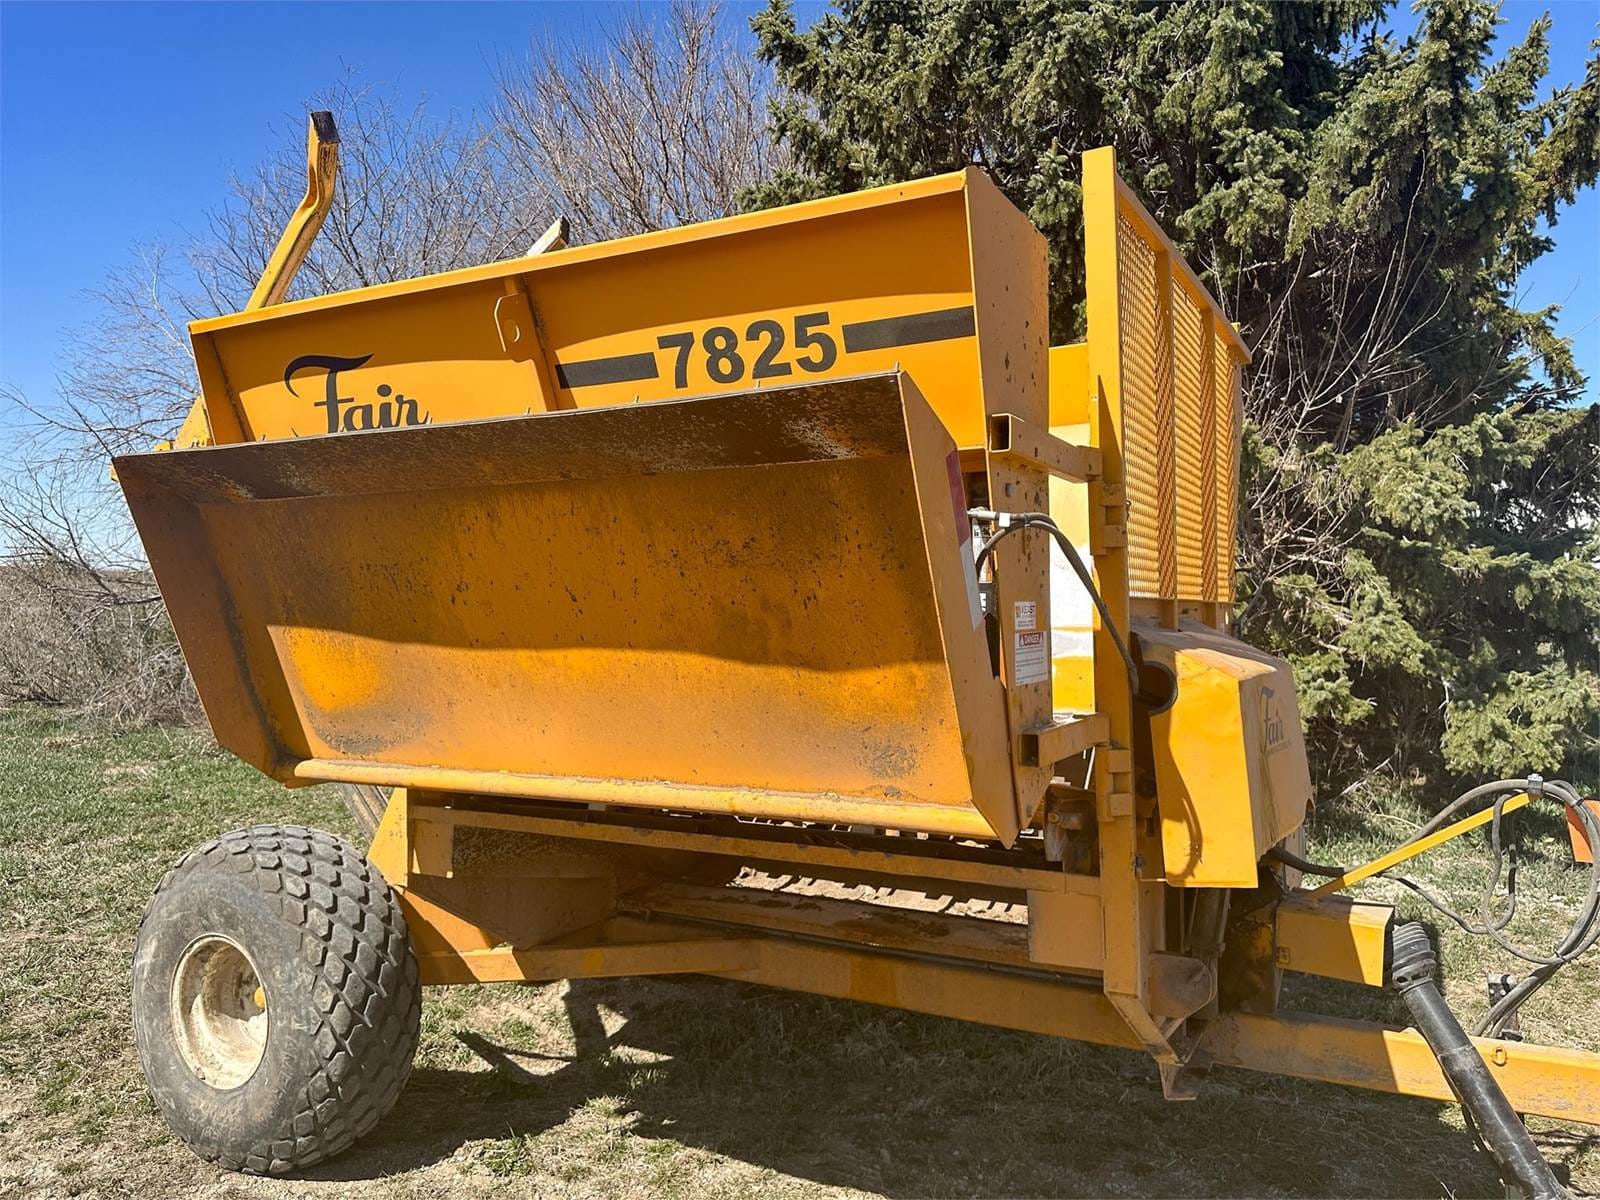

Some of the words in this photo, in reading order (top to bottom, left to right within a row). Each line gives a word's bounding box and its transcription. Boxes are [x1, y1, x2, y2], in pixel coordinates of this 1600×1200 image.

[656, 311, 838, 389] 7825
[284, 353, 430, 433] Fair
[1258, 686, 1285, 752] Fair
